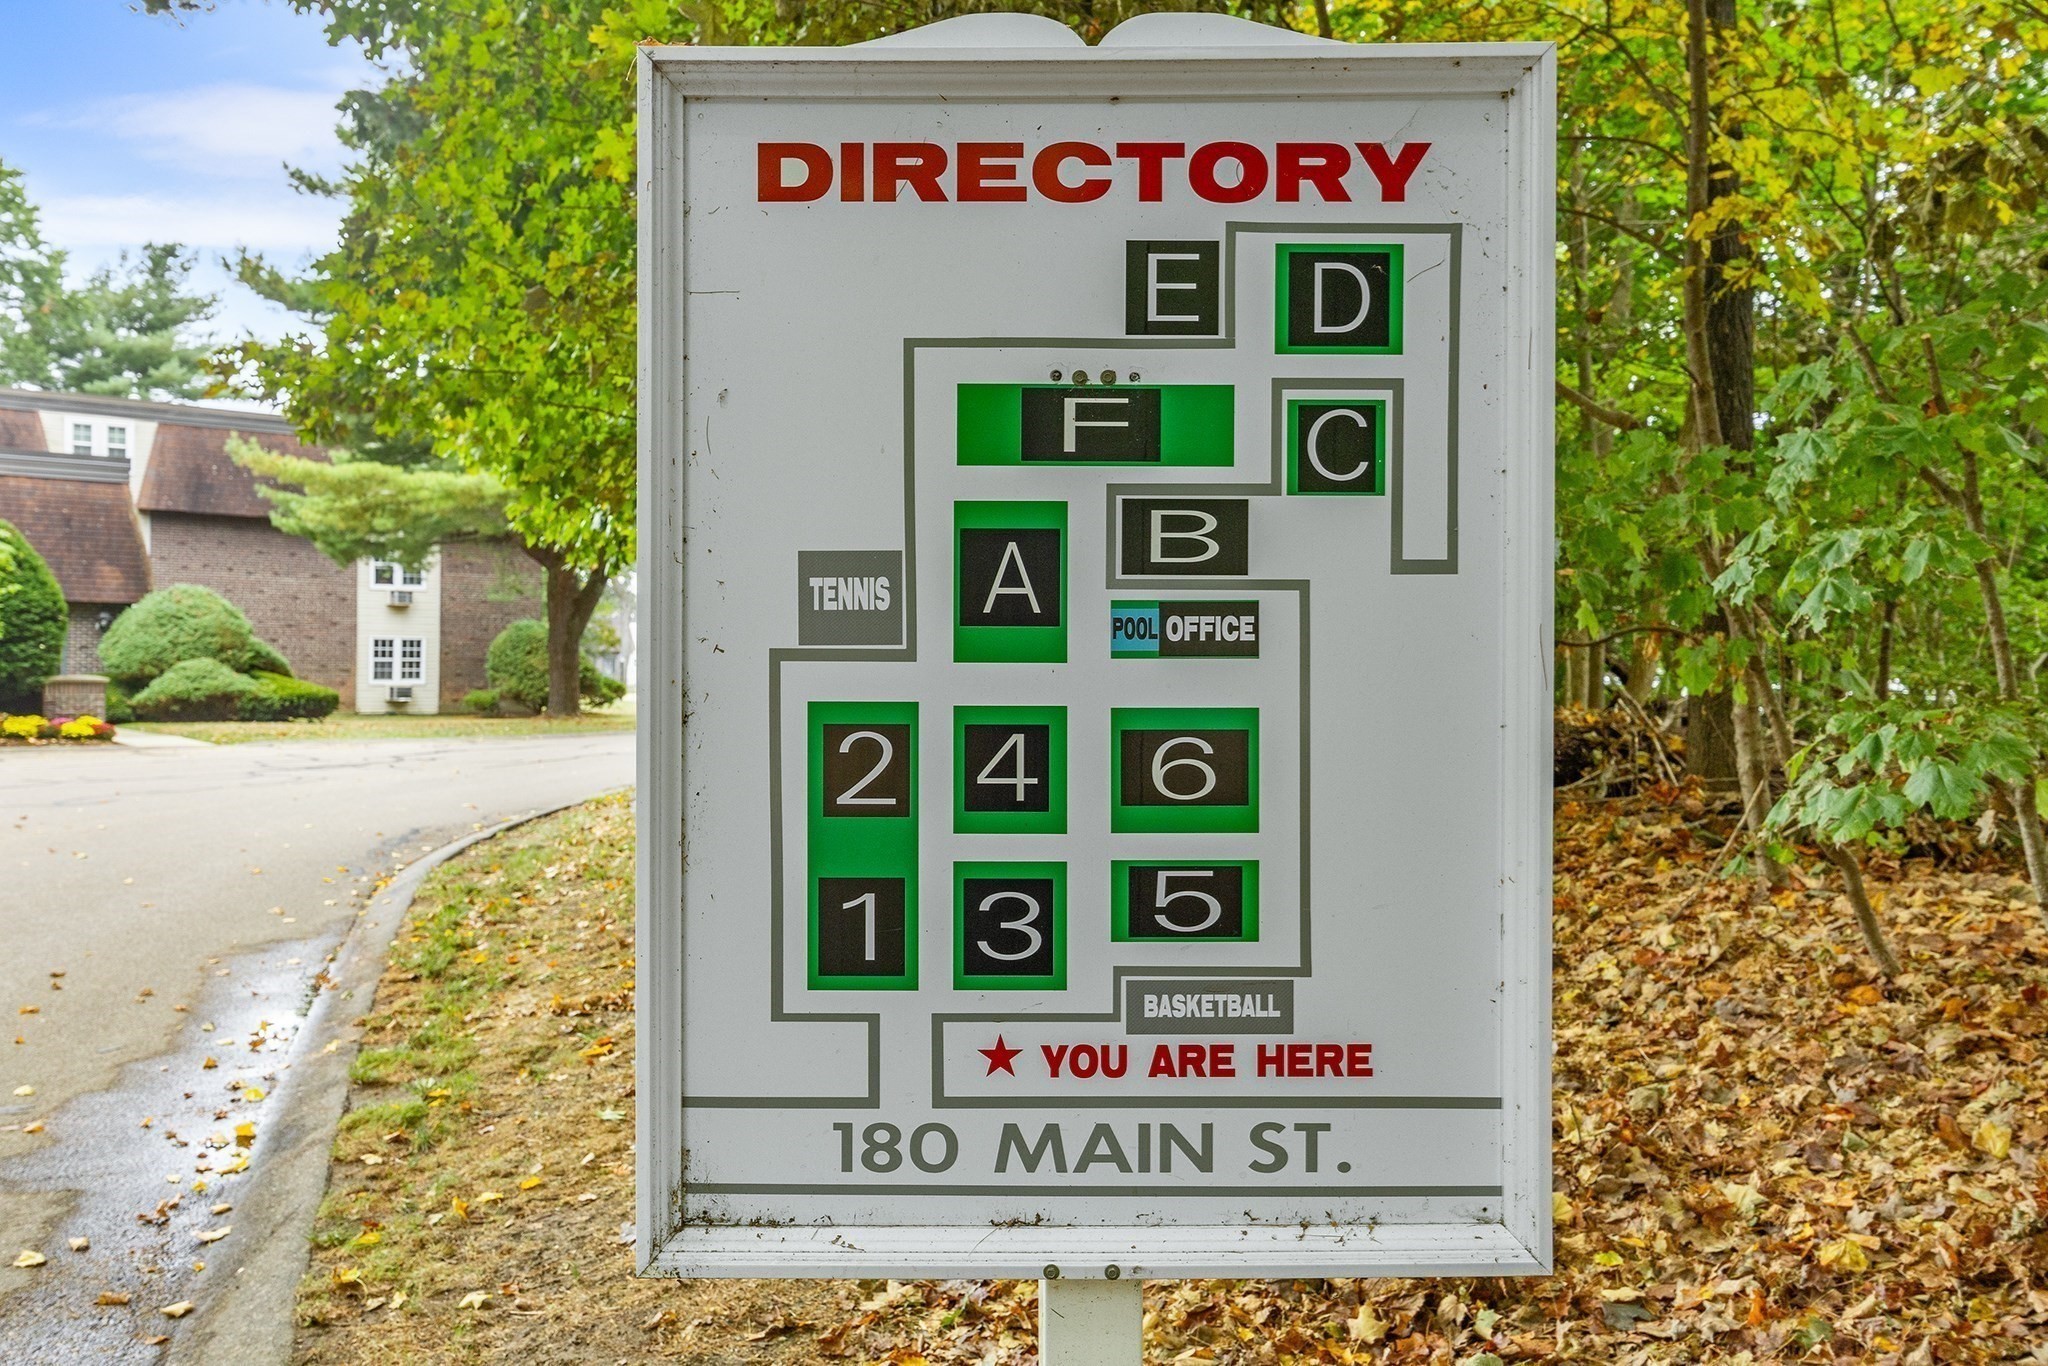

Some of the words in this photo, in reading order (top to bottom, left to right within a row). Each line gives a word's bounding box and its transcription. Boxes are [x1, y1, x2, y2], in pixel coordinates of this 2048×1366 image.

[757, 141, 1432, 203] DIRECTORY
[1147, 252, 1200, 322] E
[1313, 262, 1371, 334] D
[1062, 396, 1130, 453] F
[1307, 408, 1369, 481] C
[1150, 509, 1220, 563] B
[809, 576, 891, 612] TENNIS
[984, 541, 1041, 614] A
[1112, 615, 1158, 642] POOL
[1166, 615, 1256, 642] OFFICE
[836, 731, 897, 806] 2
[976, 733, 1039, 801] 4
[1151, 736, 1217, 801] 6
[842, 892, 877, 961] 1
[976, 891, 1043, 961] 3
[1154, 870, 1222, 933] 5
[1143, 994, 1281, 1019] BASKETBALL
[1040, 1043, 1128, 1079] YOU
[1148, 1043, 1236, 1079] ARE
[1257, 1043, 1374, 1079] HERE
[834, 1122, 958, 1174] 180
[995, 1123, 1214, 1174] MAIN
[1248, 1122, 1353, 1174] ST.
